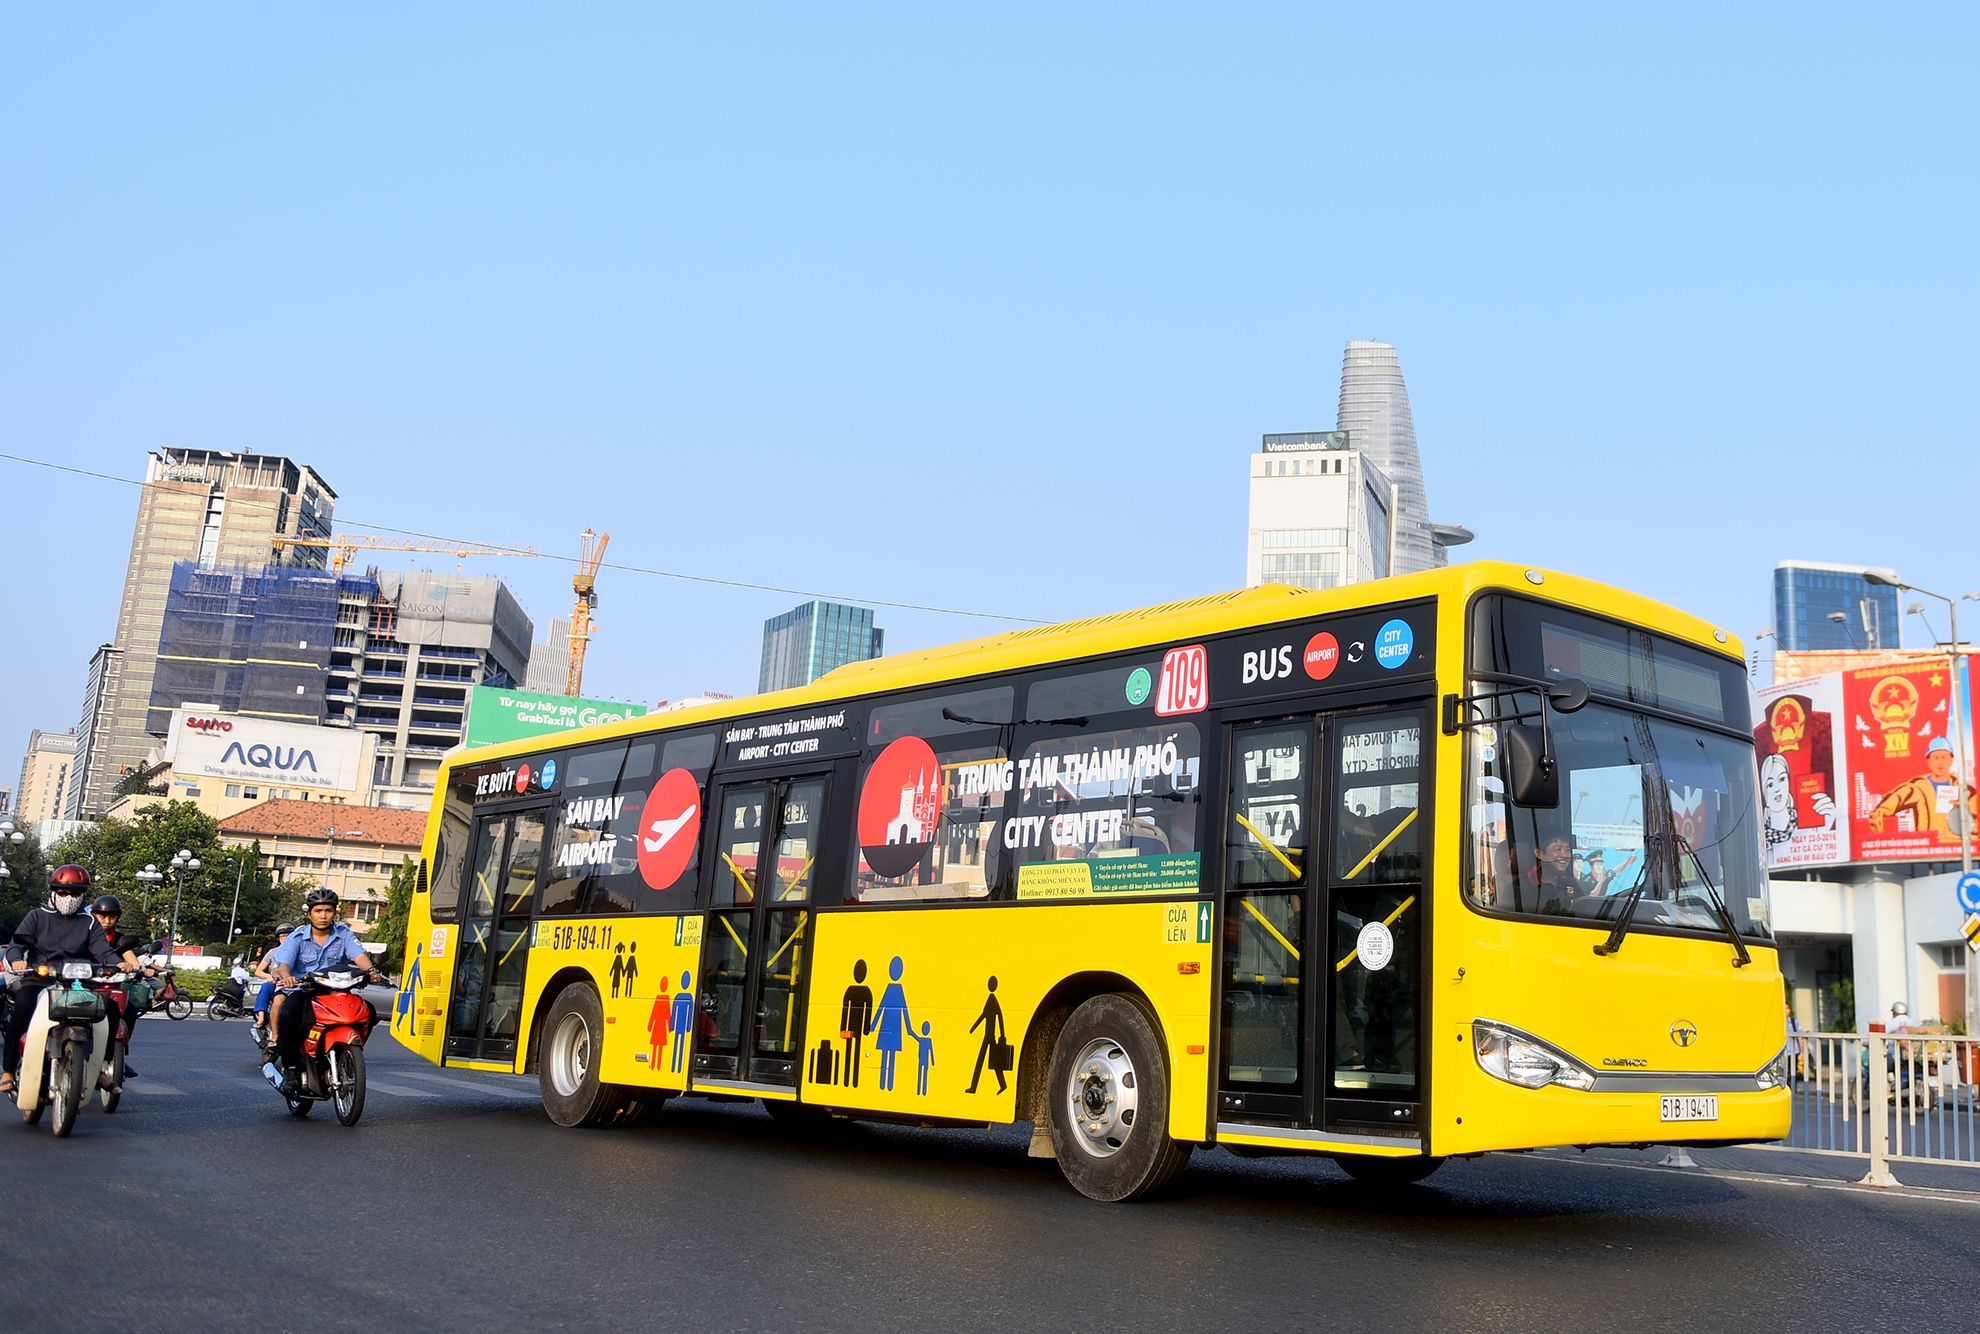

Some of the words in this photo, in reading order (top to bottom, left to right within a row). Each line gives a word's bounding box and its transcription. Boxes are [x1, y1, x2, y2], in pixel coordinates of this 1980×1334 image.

[1266, 441, 1328, 452] Vietcombank
[401, 601, 444, 614] SAIGON
[1384, 630, 1402, 643] CITY
[1306, 648, 1337, 663] AIRPORT
[1379, 643, 1409, 659] CENTER
[1242, 644, 1293, 684] BUS
[1165, 649, 1203, 710] 109
[703, 691, 734, 700] SUNWAH
[499, 696, 515, 707] Từ
[515, 701, 536, 712] nay
[537, 701, 558, 715] hãy
[559, 706, 578, 717] gọi
[186, 717, 233, 733] SANYO
[517, 712, 564, 727] GrabTaxi
[565, 716, 576, 728] là
[725, 729, 741, 744] SÂN
[739, 726, 755, 741] BAY
[758, 723, 783, 739] TRUNG
[783, 720, 800, 735] TÂM
[799, 714, 827, 733] THÀNH
[827, 710, 846, 729] PHỐ
[44, 739, 76, 747] CARAVELLE
[738, 745, 770, 761] AIRPORT
[773, 742, 791, 757] CITY
[790, 738, 819, 754] CENTER
[1883, 732, 1910, 751] XIV
[220, 741, 317, 773] AQUA
[958, 760, 1015, 795] TRUNG
[1018, 752, 1059, 790] TÂM
[1063, 746, 1131, 785] THÀNH
[1134, 732, 1179, 776] PHỐ
[475, 774, 490, 796] XE
[488, 766, 516, 794] BUÝT
[565, 796, 594, 825] SÂN
[593, 795, 625, 822] BAY
[1004, 815, 1046, 849] CITY
[1051, 808, 1123, 846] CENTER
[1808, 832, 1837, 843] 22-5-2016
[557, 840, 618, 867] AIRPORT
[1021, 868, 1037, 876] CÔNG
[1037, 876, 1057, 885] KHÔNG
[1093, 884, 1103, 892] Ghi
[1020, 888, 1044, 898] Hotline:
[1045, 888, 1059, 896] 0913
[1069, 887, 1077, 895] 50
[1077, 886, 1086, 895] 98
[1168, 904, 1188, 923] CỬA
[553, 924, 613, 951] 51B-194.11
[683, 931, 701, 946] XUỐNG
[1167, 925, 1187, 942] LÊN
[1602, 1057, 1648, 1067] DAEWOO
[1661, 1097, 1716, 1118] 51B-194.11
